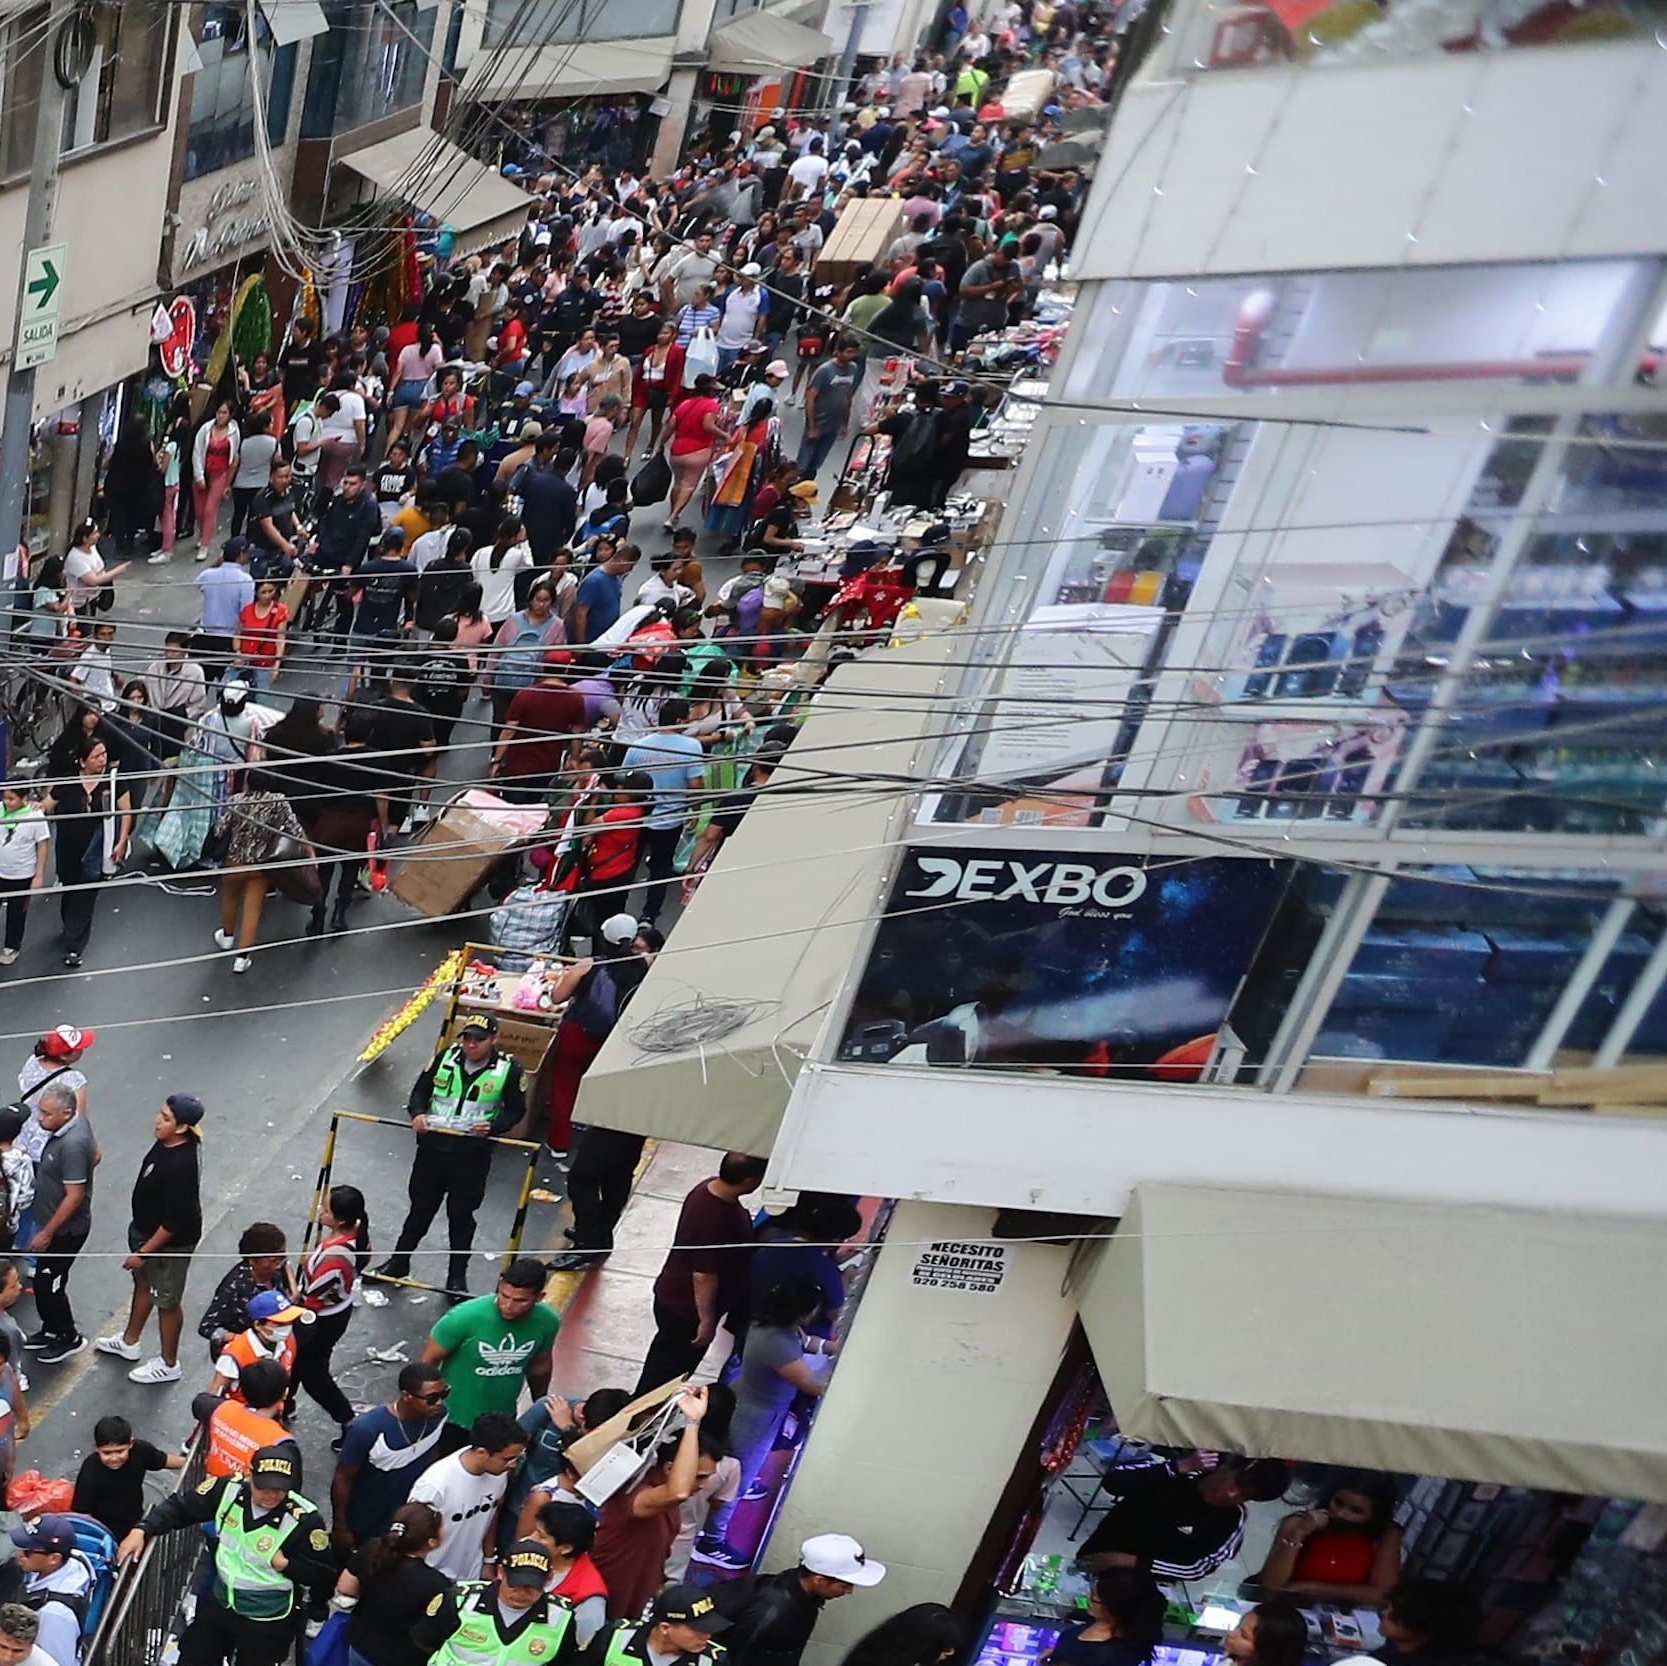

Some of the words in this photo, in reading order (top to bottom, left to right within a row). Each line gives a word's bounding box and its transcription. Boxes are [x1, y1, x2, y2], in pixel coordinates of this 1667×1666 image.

[23, 323, 54, 345] SALIDA
[904, 856, 1147, 907] DEXBO
[930, 1242, 1004, 1258] NECESITO
[920, 1253, 1005, 1272] SEÑORITAS
[913, 1276, 938, 1287] 920
[969, 1283, 996, 1293] 580
[474, 1364, 523, 1377] adidas
[256, 1458, 292, 1476] POLICIA
[510, 1552, 548, 1572] POLICIA
